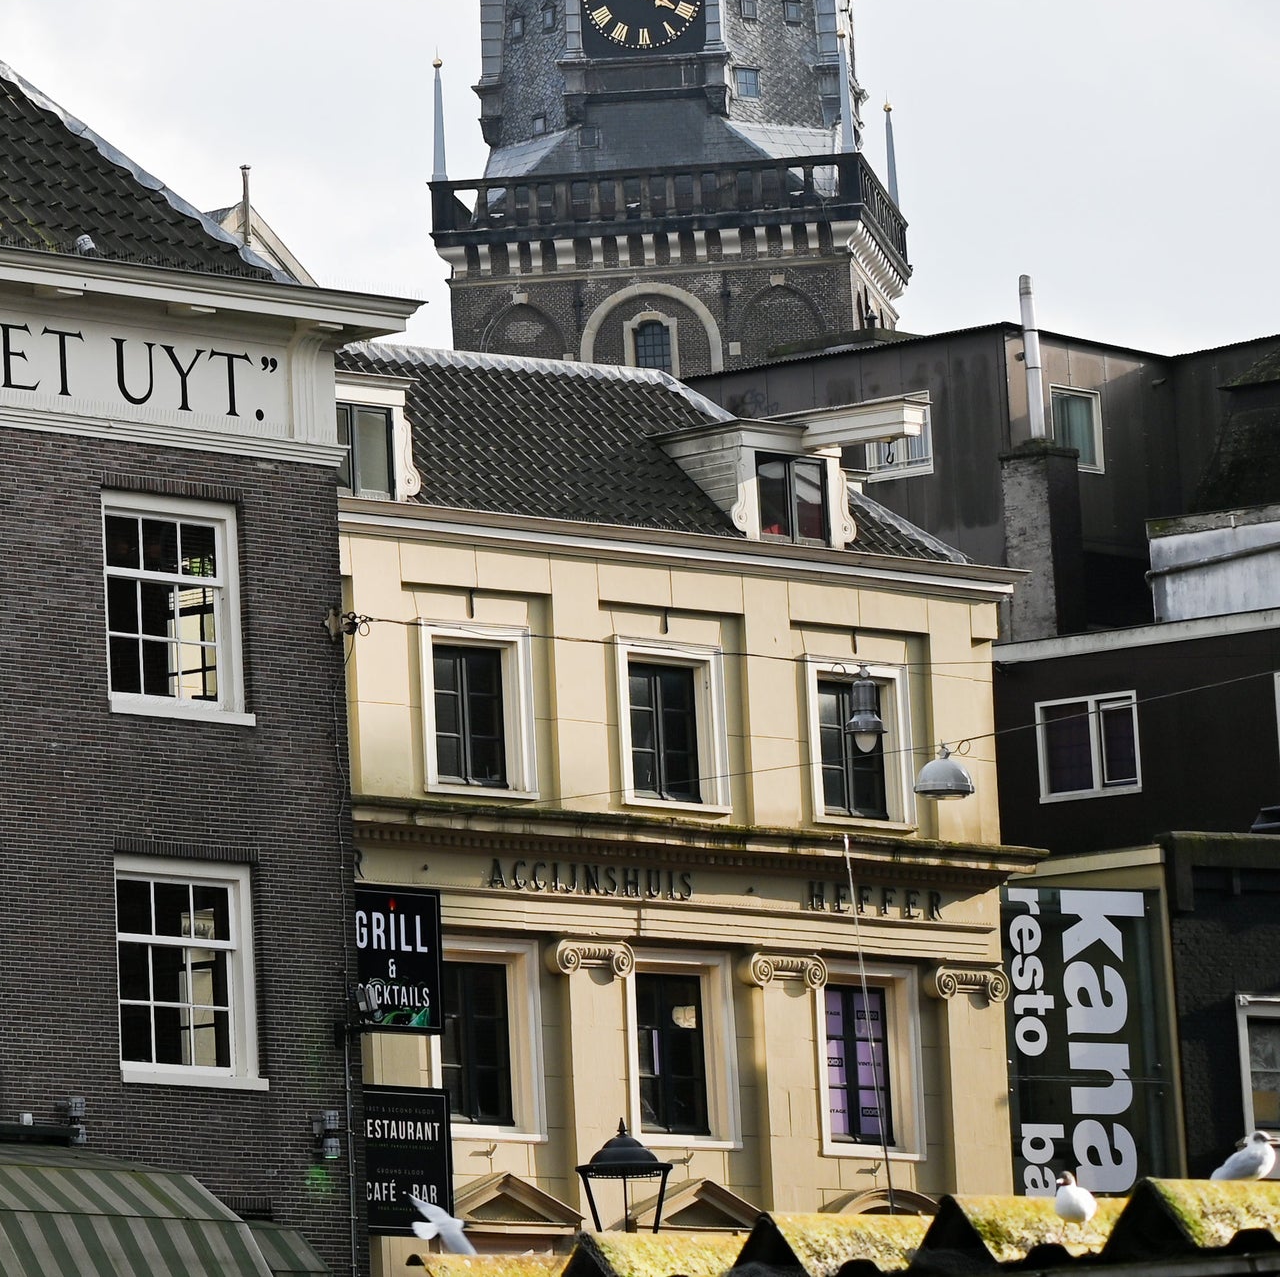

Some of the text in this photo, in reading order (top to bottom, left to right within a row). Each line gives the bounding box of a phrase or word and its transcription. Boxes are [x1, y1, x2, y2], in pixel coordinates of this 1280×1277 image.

[808, 880, 943, 921] HEFFER
[355, 910, 428, 953] GRILL
[388, 958, 396, 978] &
[1007, 888, 1055, 1057] resto
[364, 1119, 440, 1141] ESTAURANT
[367, 1179, 396, 1201] CAFÉ
[412, 1184, 438, 1204] BAR
